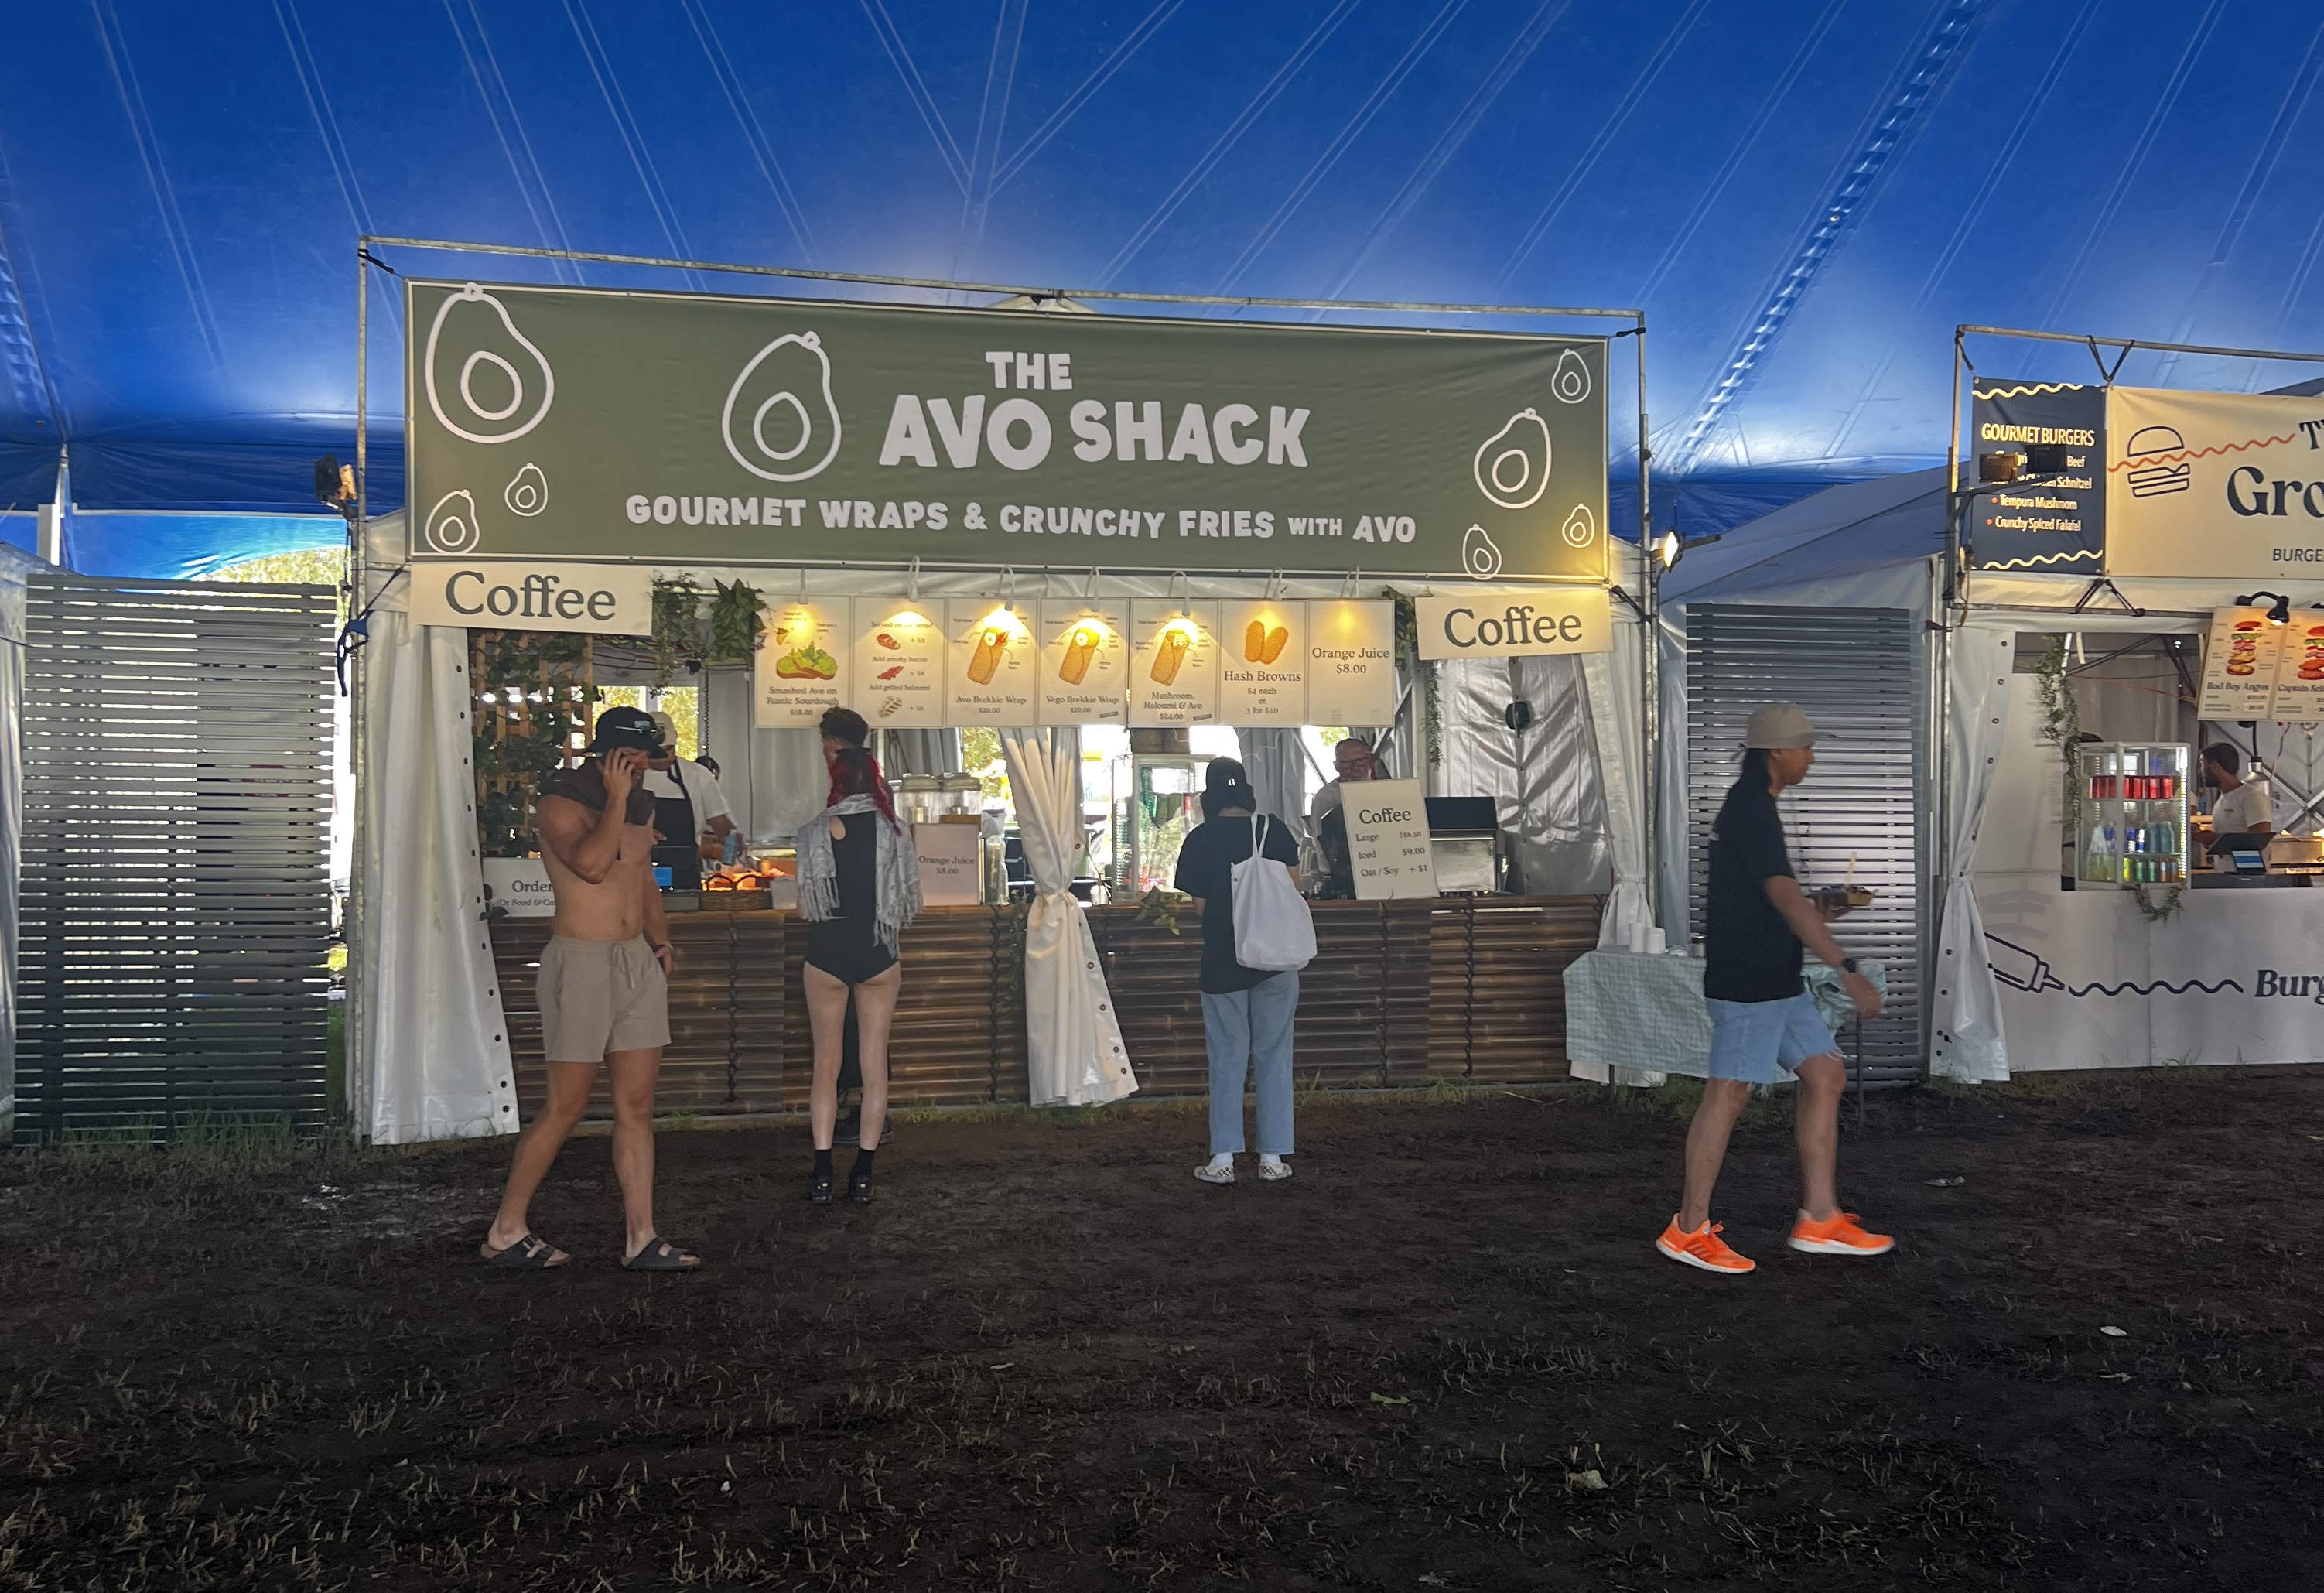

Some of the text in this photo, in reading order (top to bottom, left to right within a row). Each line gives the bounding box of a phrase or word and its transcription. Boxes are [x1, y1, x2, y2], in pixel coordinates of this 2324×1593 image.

[986, 351, 1073, 390] THE
[879, 395, 1311, 470] AVO SHACK
[1981, 422, 2096, 446] GOURMET BURGERS
[2066, 455, 2086, 467] Beef
[2056, 477, 2093, 490] Schnitzel
[1999, 494, 2078, 510] Tempura Mushroom
[626, 495, 1417, 543] GOURMET WRAPS & CRUNCHY FRIES WITH AVO
[1995, 516, 2082, 532] Crunchy Spiced Falafel
[446, 571, 616, 620] Coffee
[1444, 606, 1583, 648] Coffee
[1312, 647, 1390, 661] Orange Juice
[1336, 664, 1367, 674] $8.00
[1224, 670, 1301, 682] Hash Browns
[767, 696, 839, 707] Rustic Sourdough
[1005, 696, 1027, 705] Wrap
[1046, 696, 1065, 705] Vego
[1098, 696, 1119, 705] Wrap
[1151, 692, 1195, 700] Mushroom,
[1359, 808, 1412, 825] Coffee
[1355, 833, 1379, 843] Large
[1358, 847, 1426, 860] Iced $9.00
[918, 856, 976, 865] Orange Juice
[1361, 868, 1376, 877] Oat
[1383, 867, 1400, 876] Soy
[512, 880, 553, 892] Order
